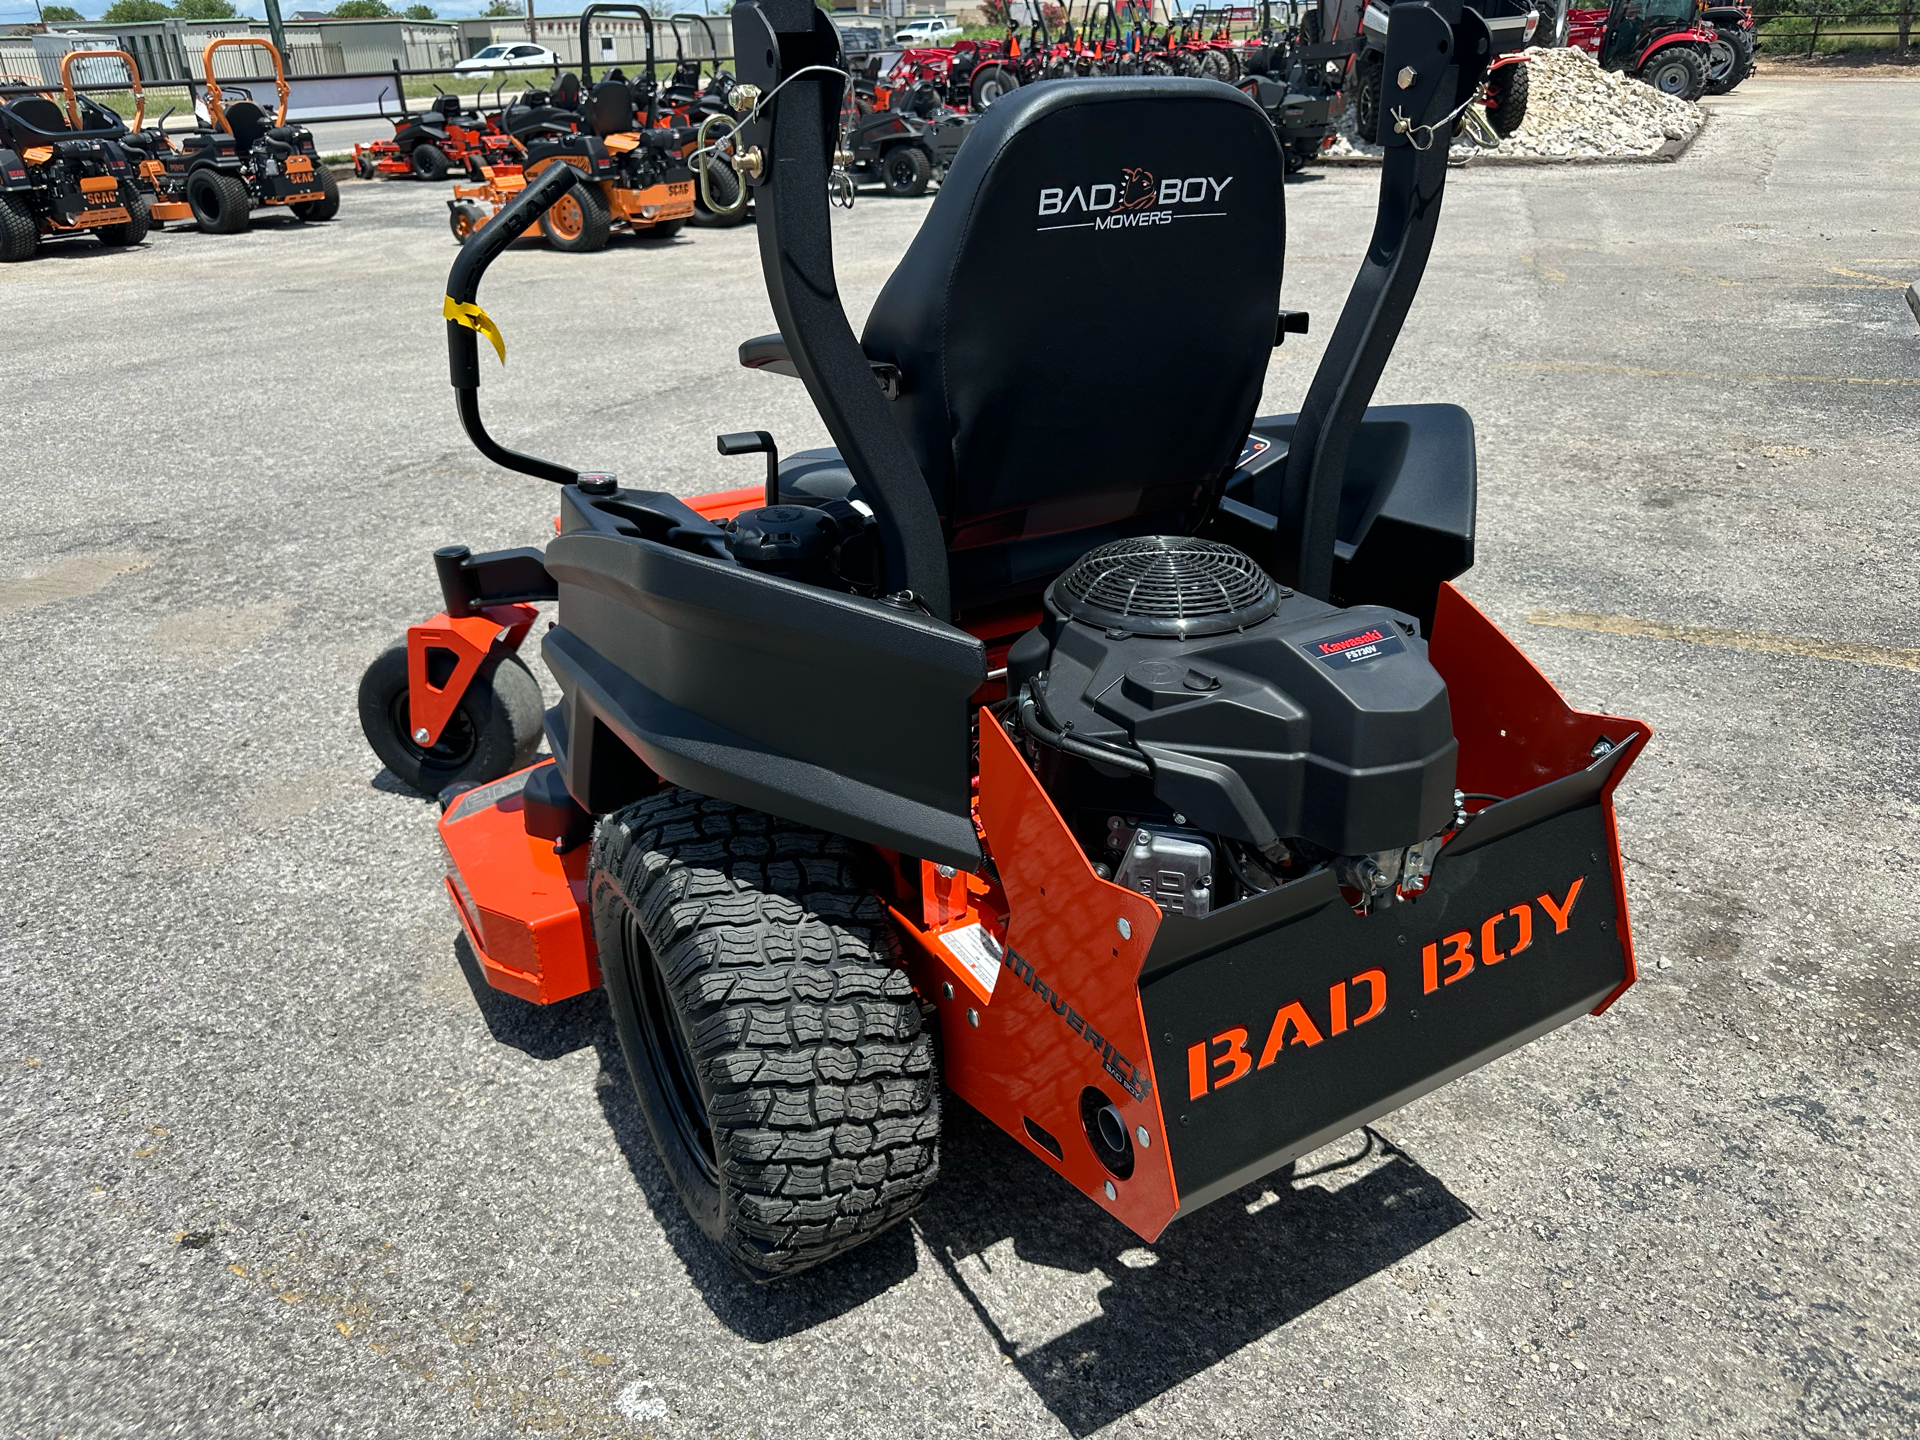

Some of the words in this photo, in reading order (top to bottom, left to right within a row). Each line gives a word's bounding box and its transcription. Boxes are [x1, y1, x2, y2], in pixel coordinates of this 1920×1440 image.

[206, 29, 226, 39] 500
[289, 173, 315, 185] SCAG
[87, 191, 117, 205] SCAG
[668, 183, 690, 197] SCAG
[1038, 183, 1116, 216] BAD
[1158, 176, 1233, 205] BOY
[1094, 210, 1172, 231] MOWERS
[1318, 629, 1384, 655] Kawasaki
[1344, 645, 1378, 660] FS730V
[1187, 965, 1388, 1102] BAD
[1421, 875, 1588, 996] BOY
[1004, 944, 1154, 1098] MAVERICK
[1105, 1063, 1123, 1083] BAD
[1123, 1080, 1141, 1099] BOY
